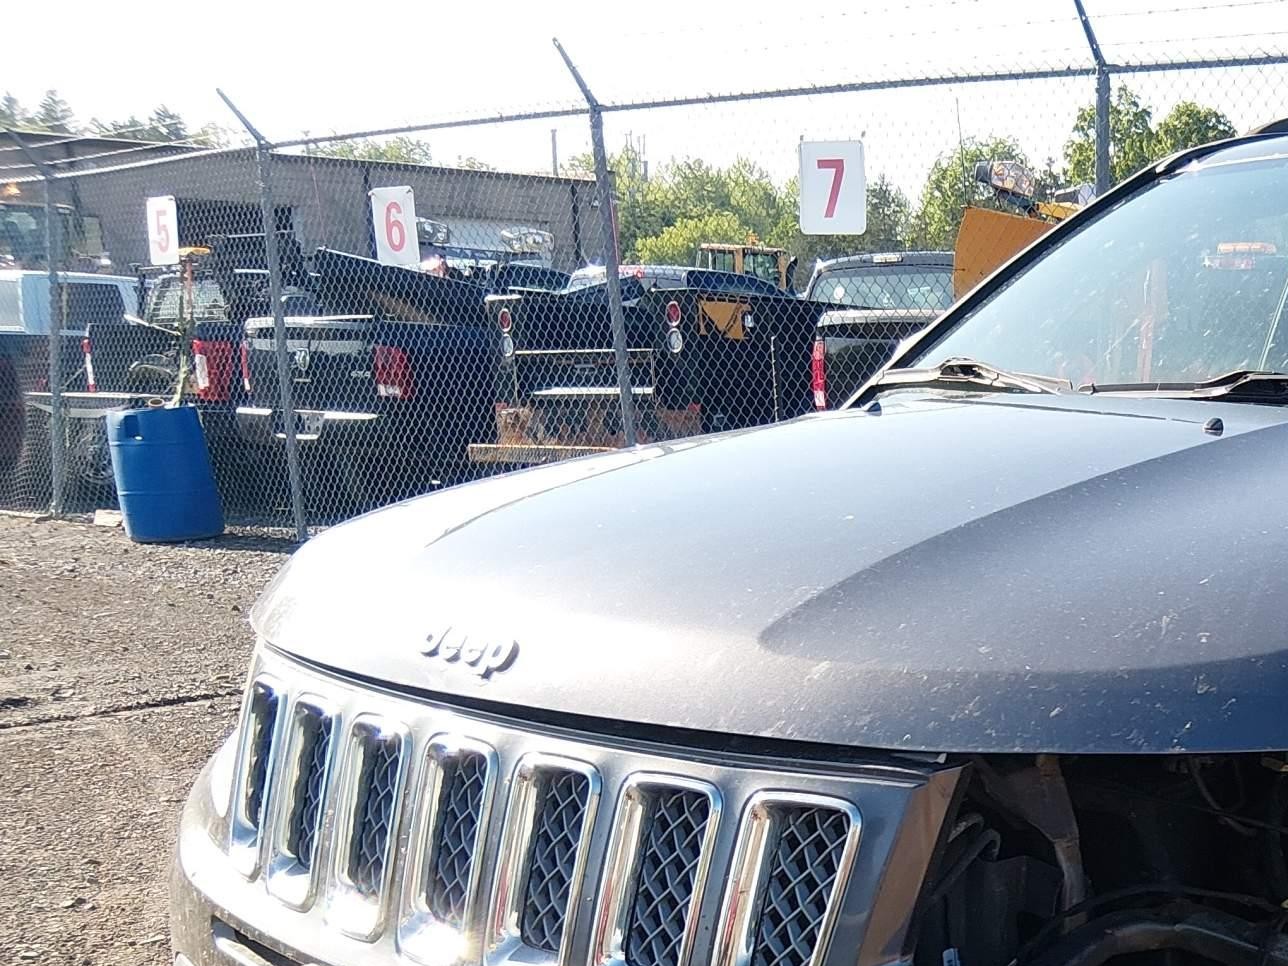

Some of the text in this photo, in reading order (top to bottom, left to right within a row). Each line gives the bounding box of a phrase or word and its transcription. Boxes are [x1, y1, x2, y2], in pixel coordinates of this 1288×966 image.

[816, 159, 844, 218] 7
[155, 209, 170, 253] 5
[385, 201, 405, 252] 6
[419, 625, 521, 684] Jeep
